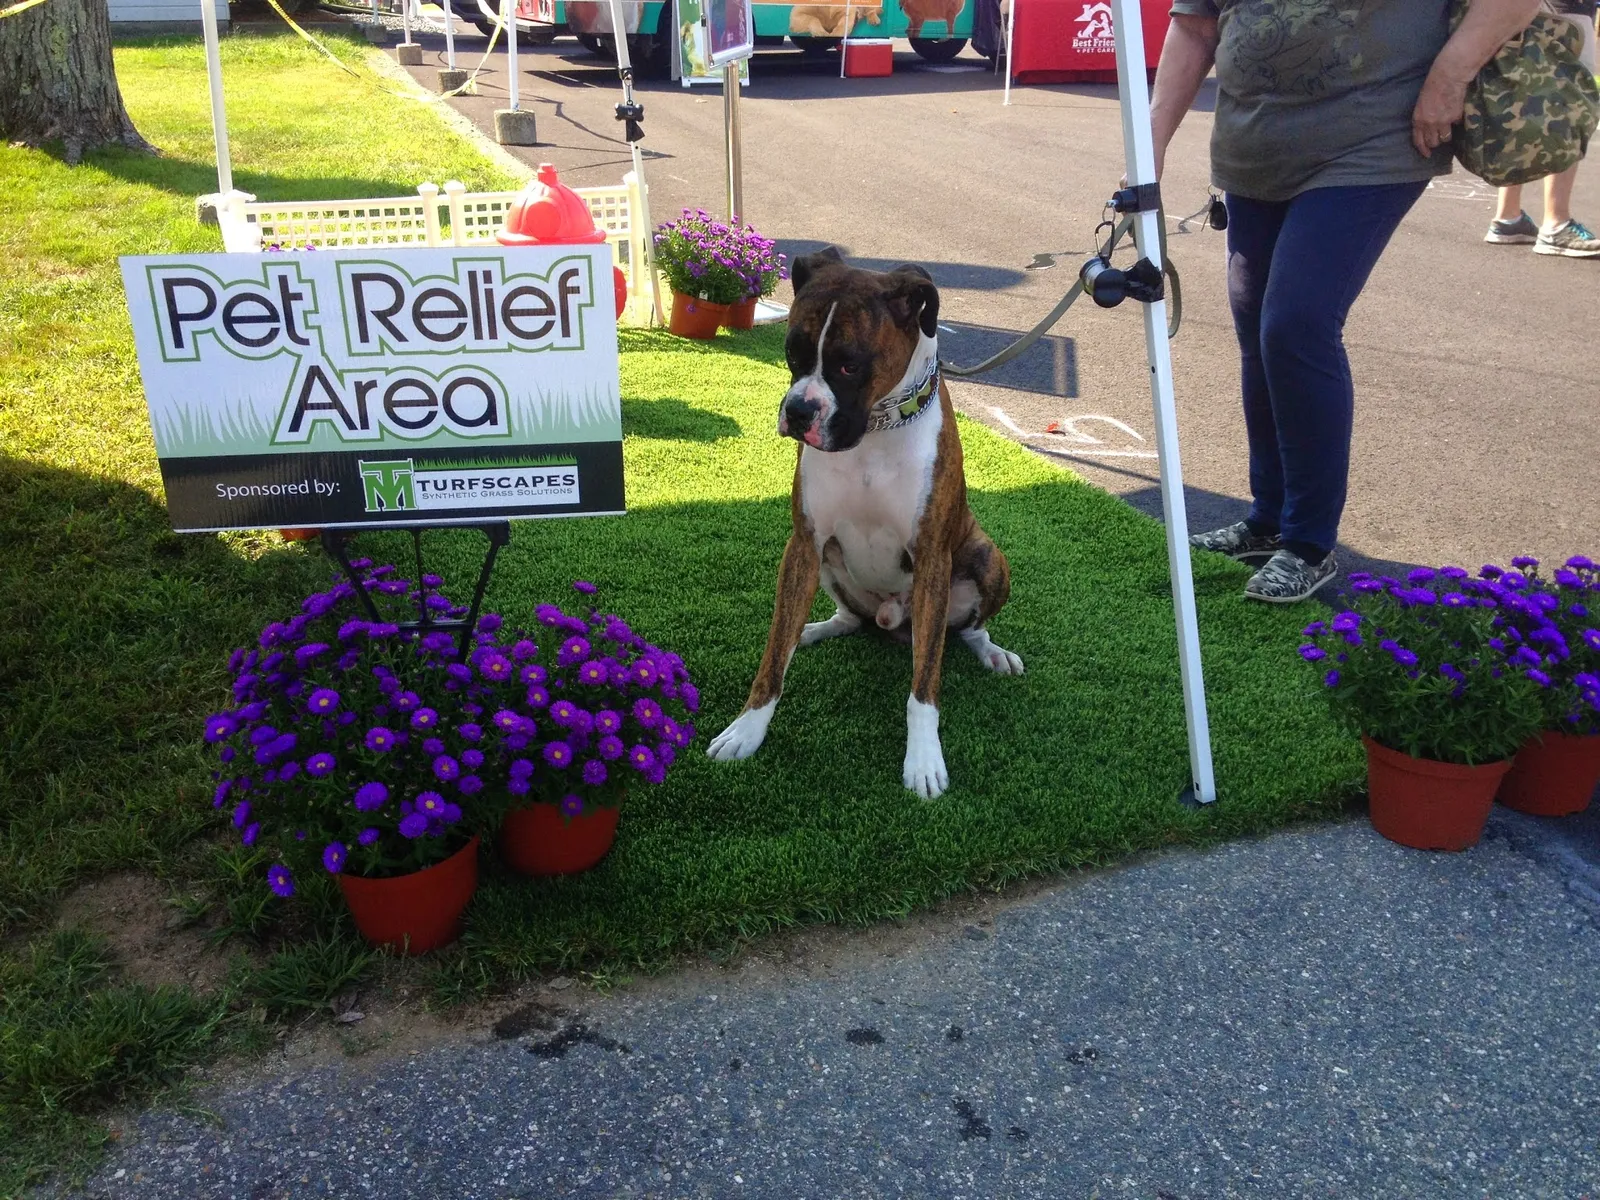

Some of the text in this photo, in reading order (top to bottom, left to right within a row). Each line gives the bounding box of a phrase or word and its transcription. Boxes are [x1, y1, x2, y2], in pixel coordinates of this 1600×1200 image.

[1072, 38, 1092, 47] Best
[161, 267, 581, 349] Pet Relief
[287, 364, 499, 433] Area
[215, 479, 341, 500] Sponsored by:
[416, 474, 576, 492] TURFSCAPES
[480, 489, 514, 498] GRASS
[517, 487, 573, 496] SOLUTIONS
